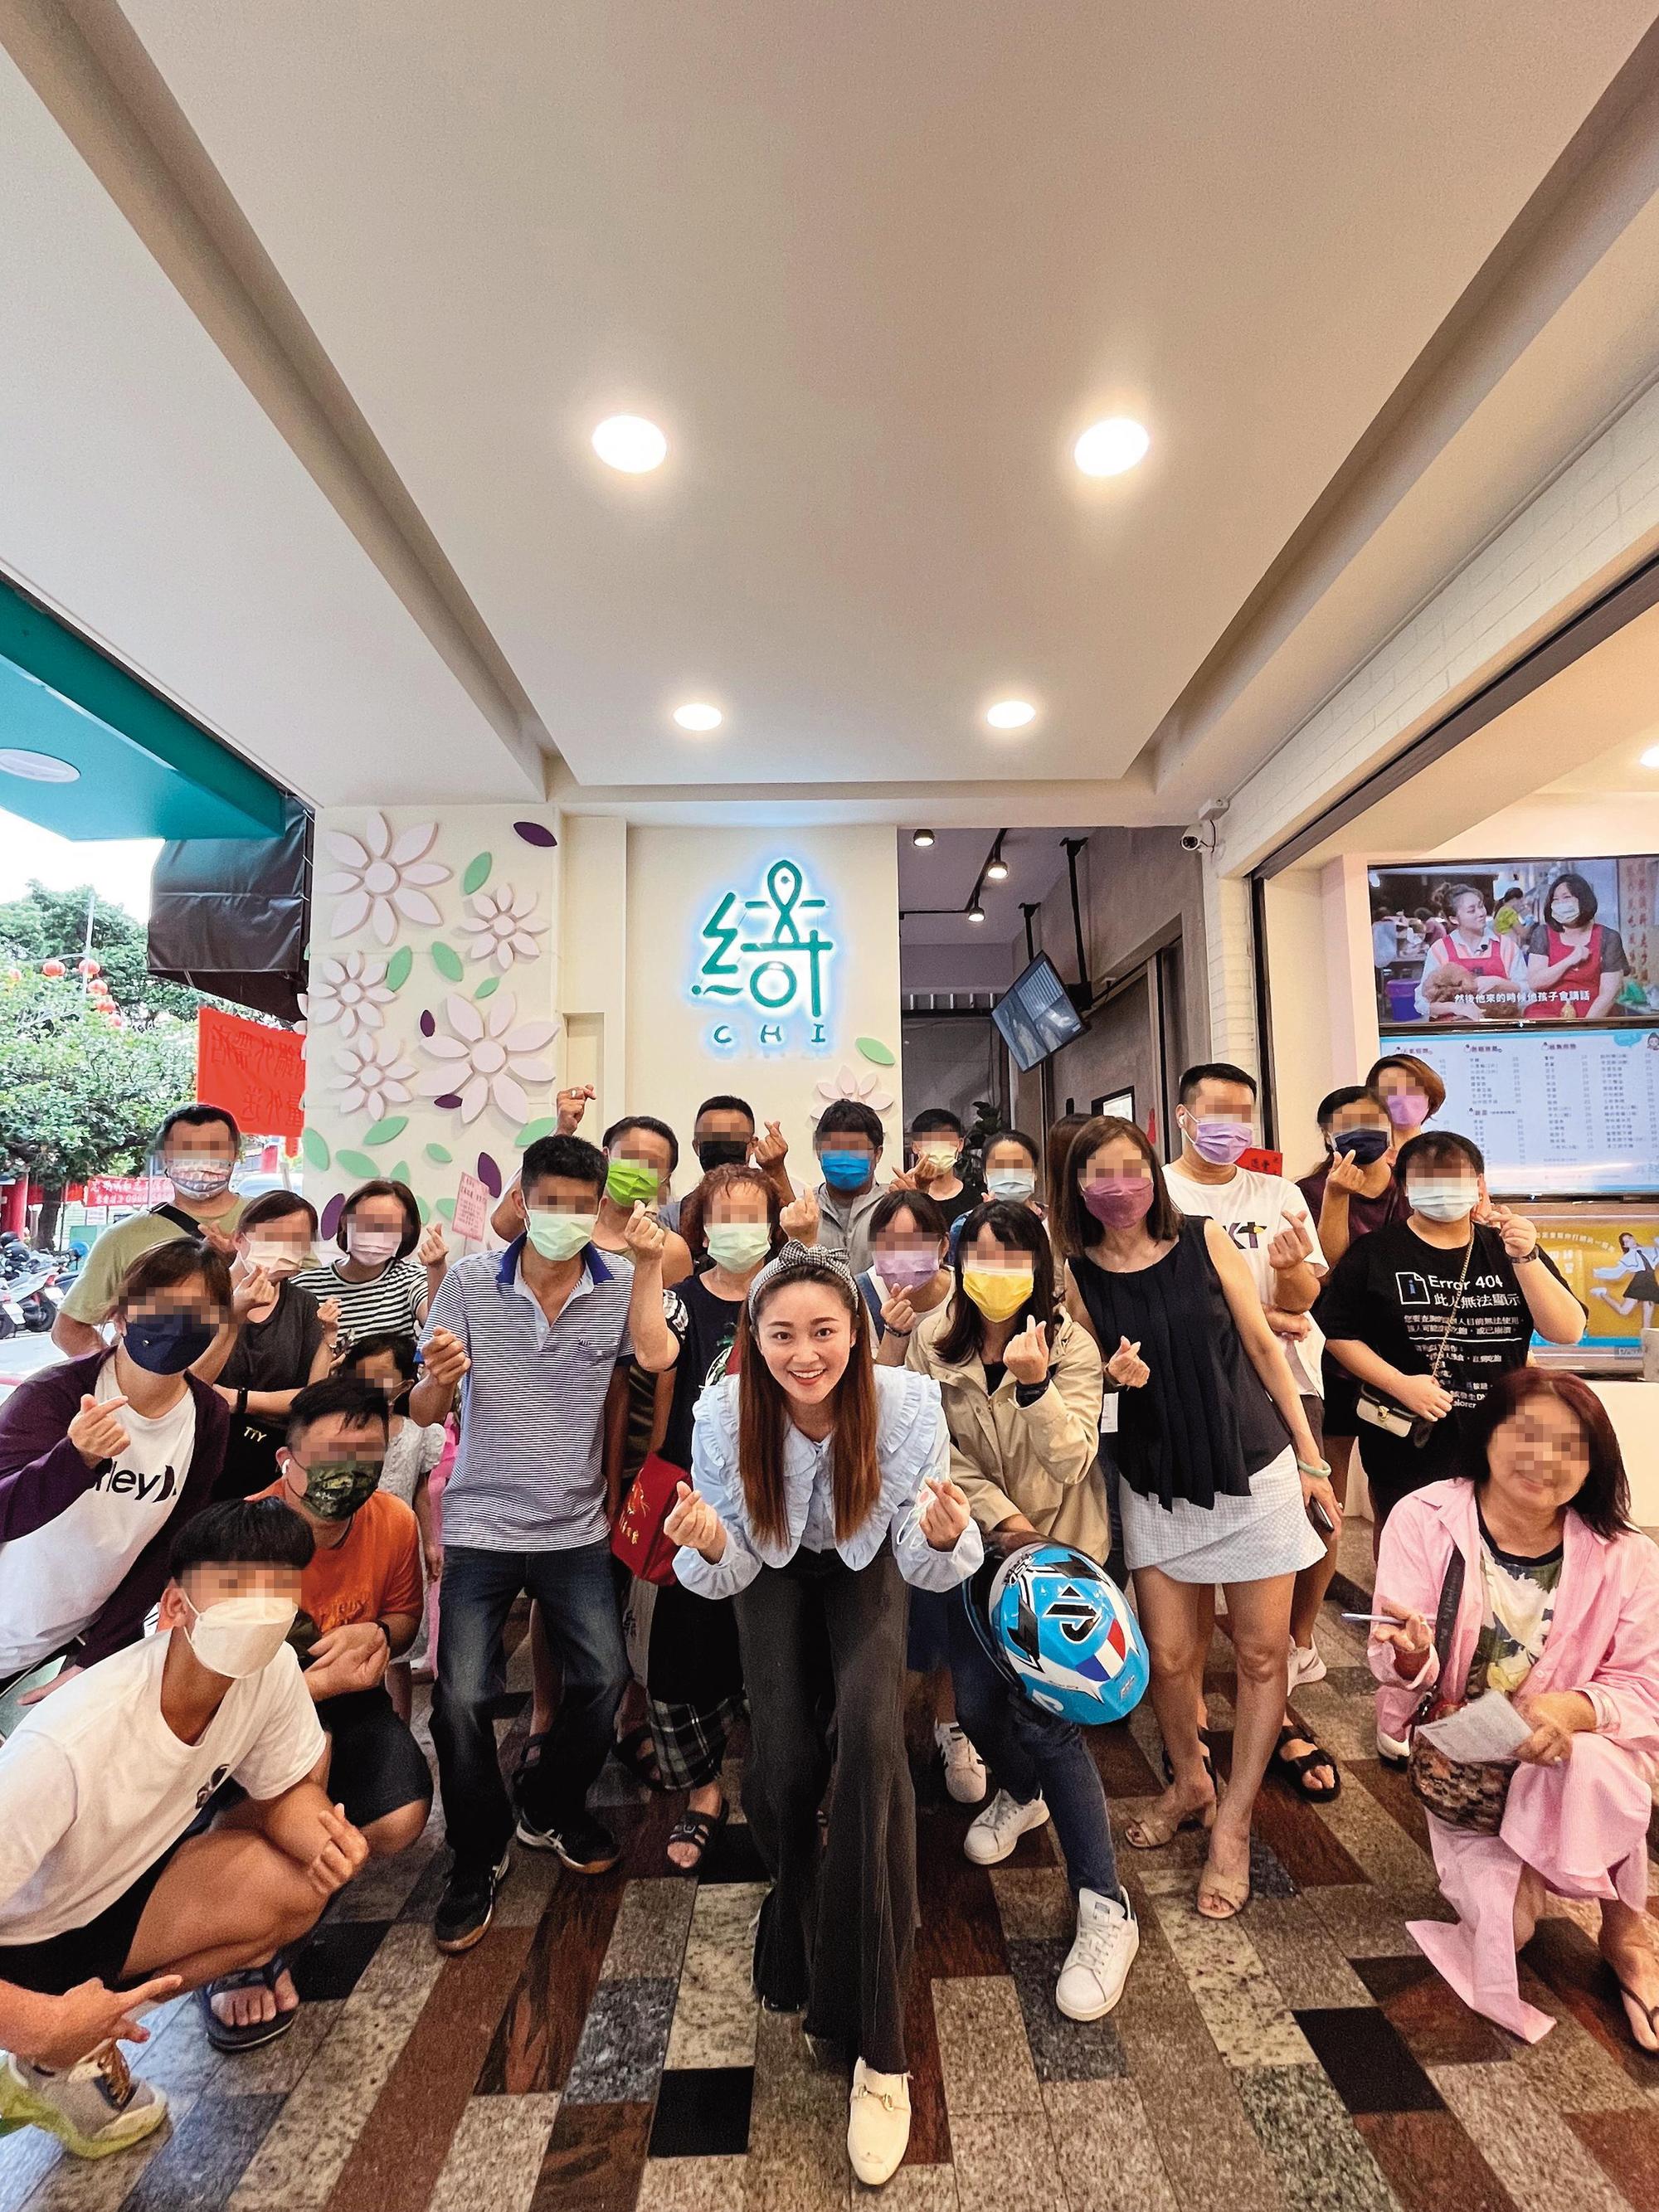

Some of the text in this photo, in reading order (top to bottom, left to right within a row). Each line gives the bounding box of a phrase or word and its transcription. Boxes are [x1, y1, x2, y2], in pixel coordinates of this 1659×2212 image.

[713, 1023, 825, 1043] CHI
[1428, 1274, 1503, 1291] Error 404
[1433, 1293, 1520, 1309] 此人無法顯示
